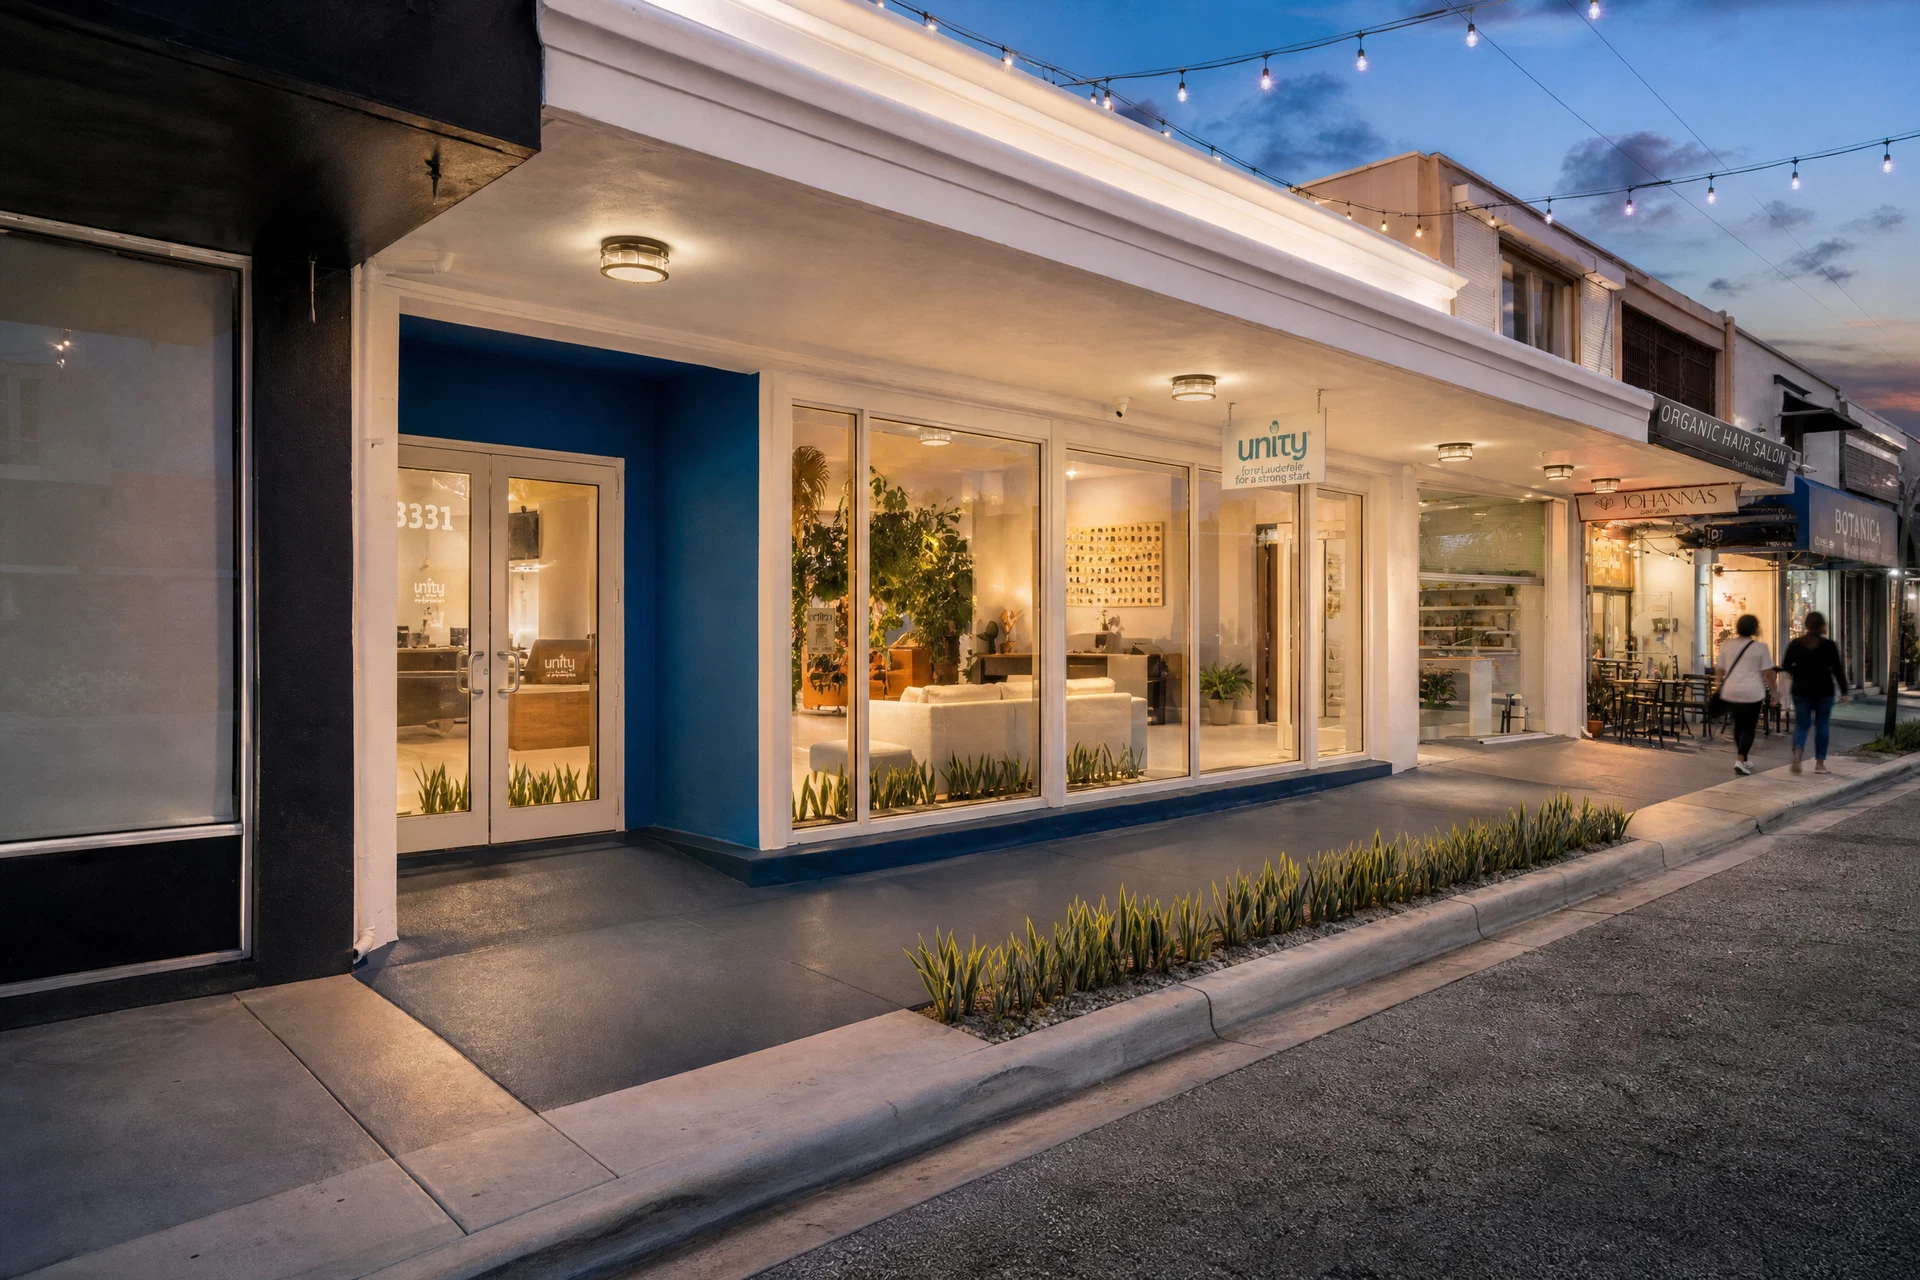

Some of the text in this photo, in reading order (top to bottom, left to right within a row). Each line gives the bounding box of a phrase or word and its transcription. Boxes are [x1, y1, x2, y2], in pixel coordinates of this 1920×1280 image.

[1238, 420, 1307, 462] unity
[1661, 404, 1787, 466] ORGANIC HAIR SALON
[1235, 471, 1311, 485] for a strong start
[1620, 488, 1718, 511] JOHANNAS
[397, 501, 454, 531] 3331
[1835, 508, 1882, 545] BOTANICA
[414, 578, 445, 598] unity
[544, 653, 575, 672] unity
